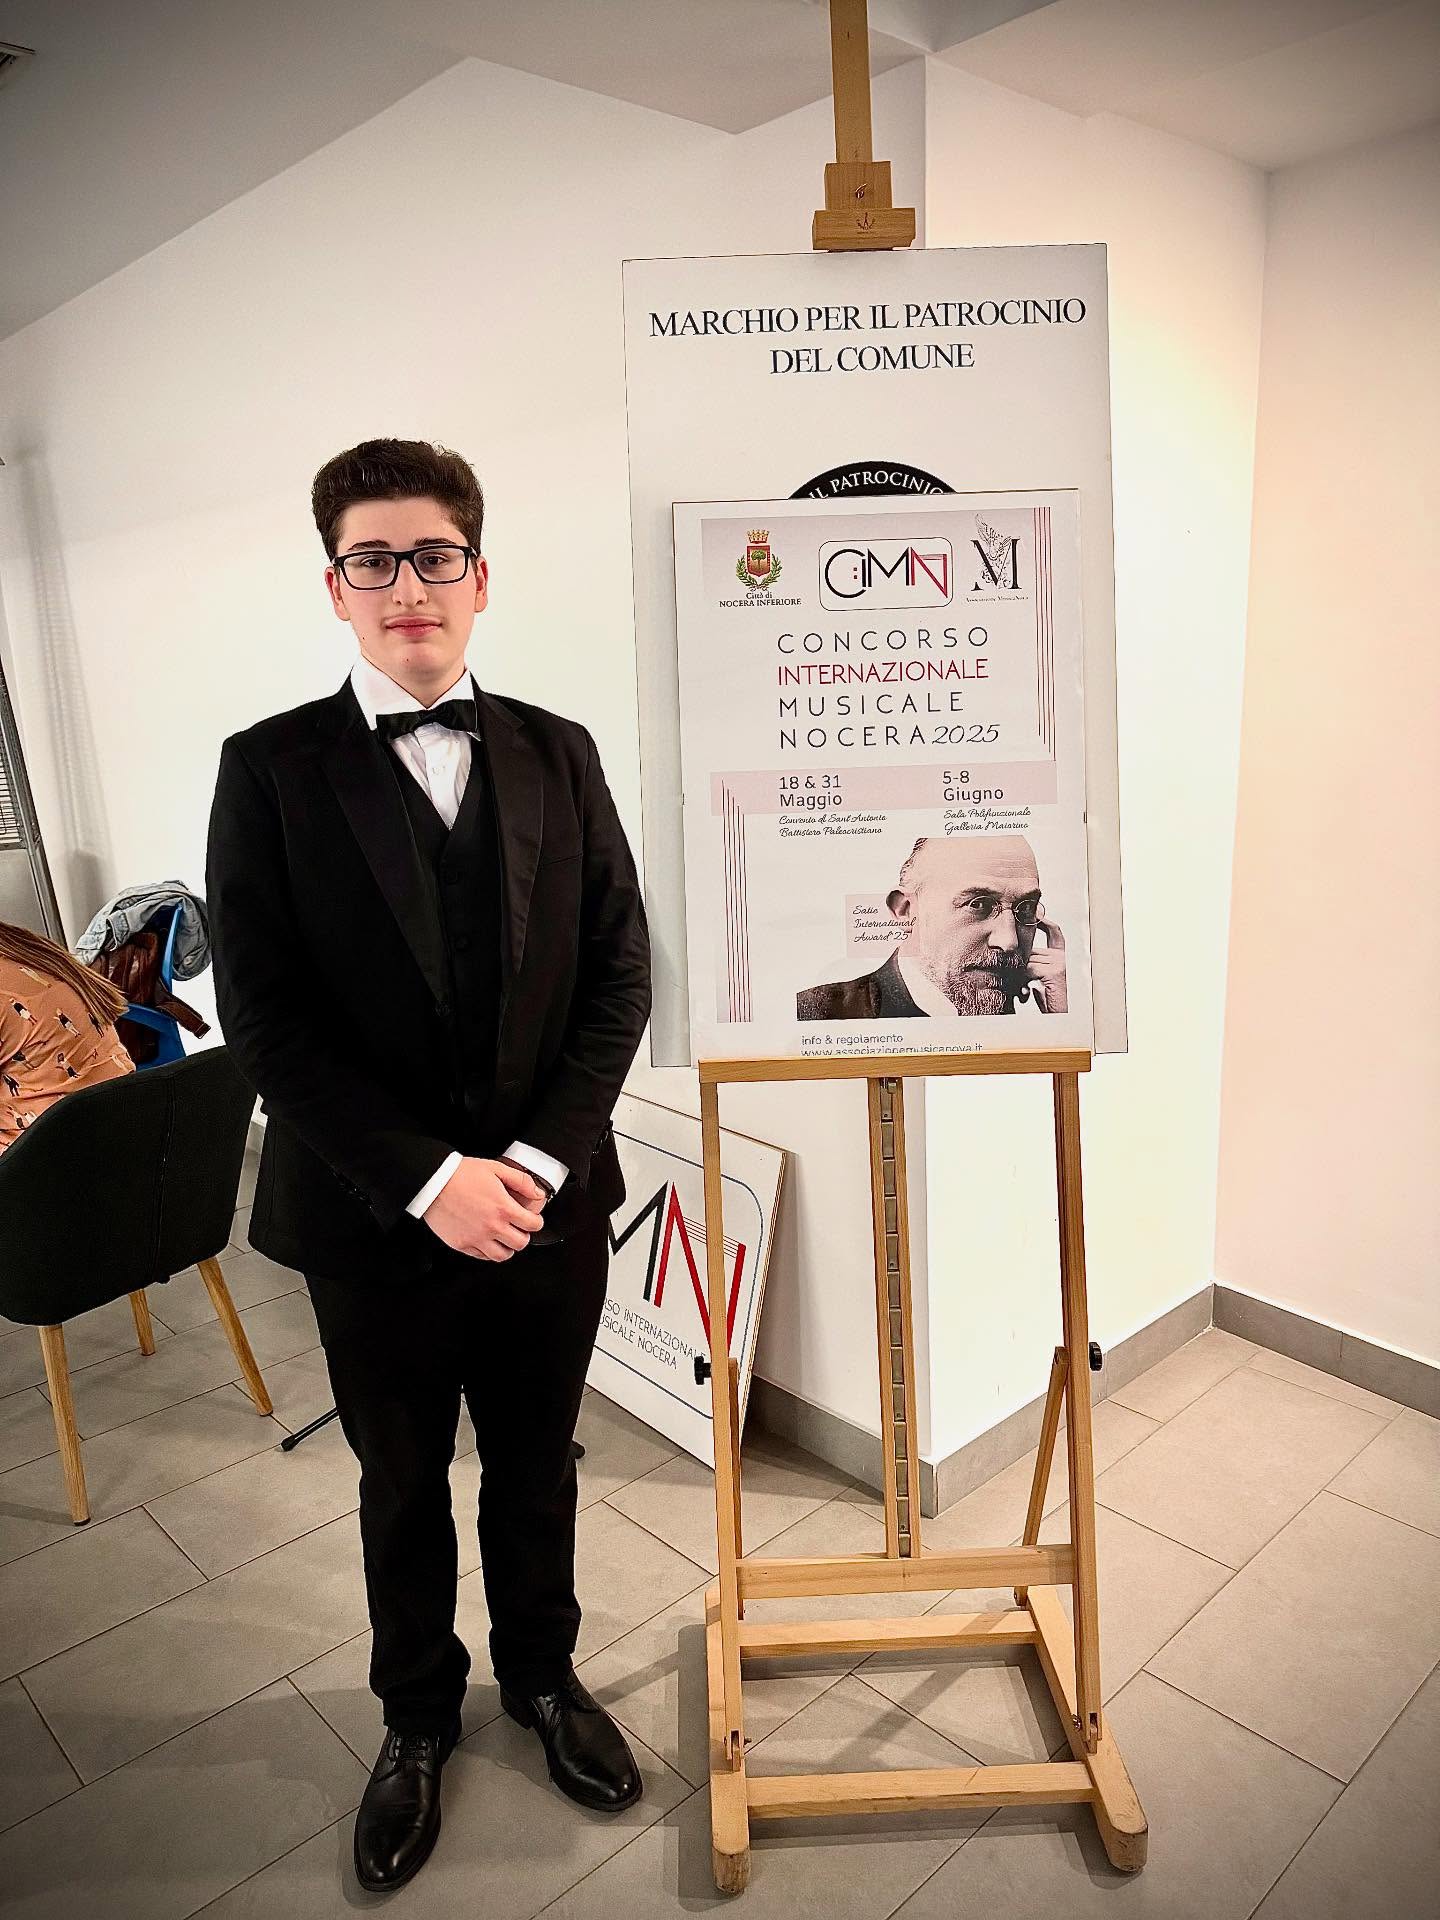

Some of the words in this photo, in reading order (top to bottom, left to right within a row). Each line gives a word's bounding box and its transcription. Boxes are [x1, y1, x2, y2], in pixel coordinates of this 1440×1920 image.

[649, 307, 798, 338] MARCHIO
[805, 305, 861, 333] PER
[869, 303, 900, 330] IL
[905, 298, 1087, 328] PATROCINIO
[769, 347, 832, 374] DEL
[837, 343, 976, 371] COMUNE
[719, 600, 755, 608] NOCERA
[756, 598, 802, 607] INFERIORE
[777, 626, 988, 654] CONCORSO
[778, 658, 989, 686] INTERNAZIONALE
[779, 691, 964, 718] MUSICALE
[780, 725, 926, 749] NOCERA
[931, 723, 1001, 745] 2025
[779, 776, 800, 790] 18
[804, 775, 817, 789] &
[821, 774, 842, 789] 31
[942, 770, 970, 785] 5-8
[780, 791, 843, 810] Maggio
[943, 786, 1004, 804] Giugno
[779, 815, 817, 825] Convento
[943, 809, 967, 819] Sala
[967, 806, 1032, 822] Polifunzionale
[779, 827, 822, 838] Battistero
[822, 825, 883, 837] Paleocristiano
[944, 821, 984, 836] Galleria
[984, 820, 1029, 831] Maiorino
[852, 904, 879, 915] Satie
[853, 916, 917, 929] International
[801, 1035, 822, 1046] info
[824, 1034, 833, 1045] &
[836, 1033, 904, 1046] regolamento
[800, 1042, 983, 1057] wwwassociazionemusicanovait
[624, 1308, 707, 1359] INTERNAZIONA
[599, 1314, 636, 1344] USICALE
[637, 1336, 677, 1370] NOCERA
